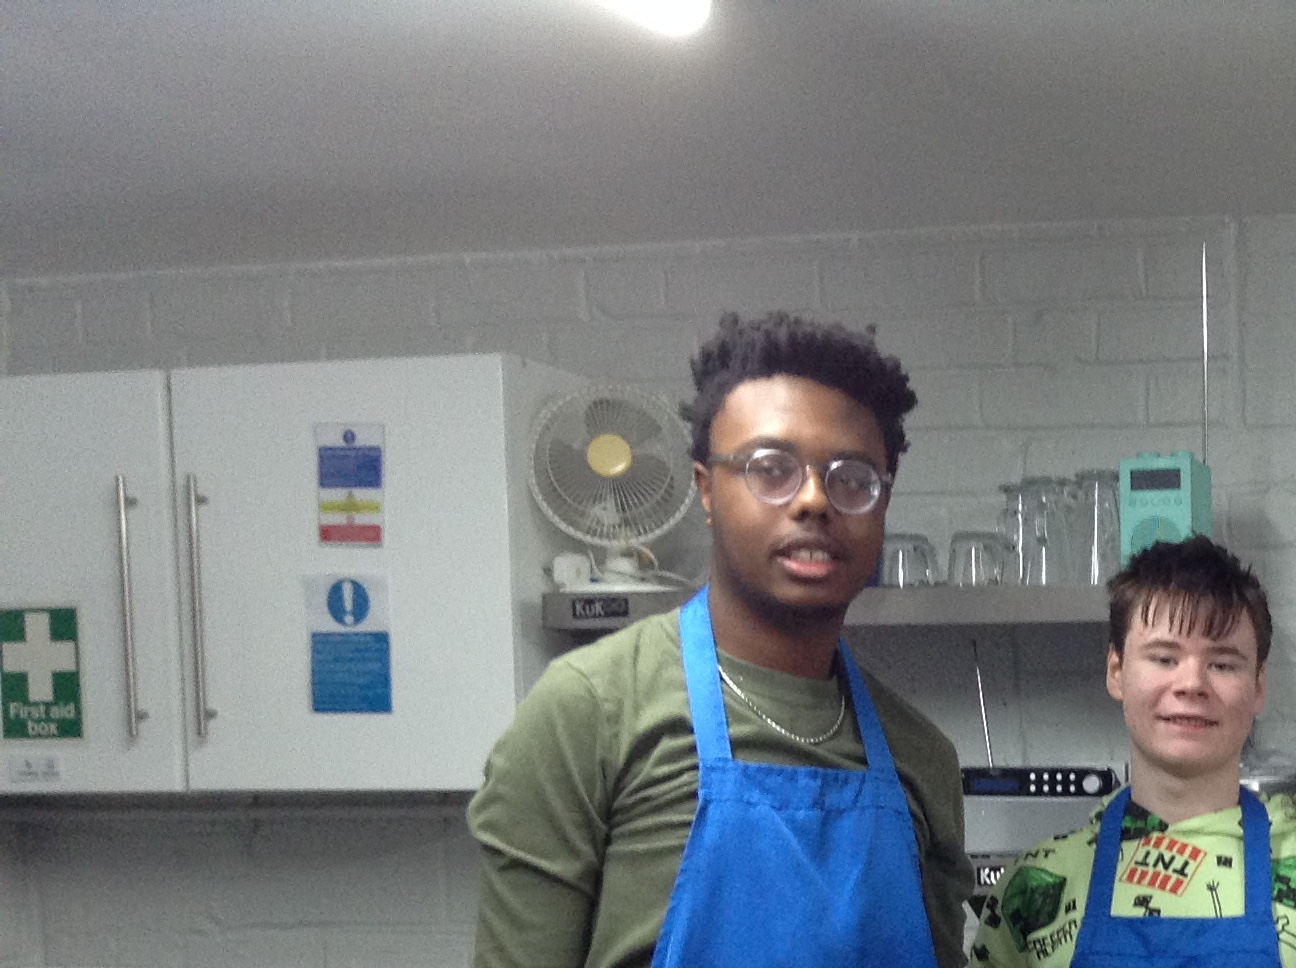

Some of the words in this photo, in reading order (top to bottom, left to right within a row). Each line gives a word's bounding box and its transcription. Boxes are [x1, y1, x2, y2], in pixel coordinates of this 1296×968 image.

[9, 702, 46, 719] First
[50, 702, 76, 719] aid
[27, 720, 58, 737] box
[1134, 850, 1190, 878] TNT
